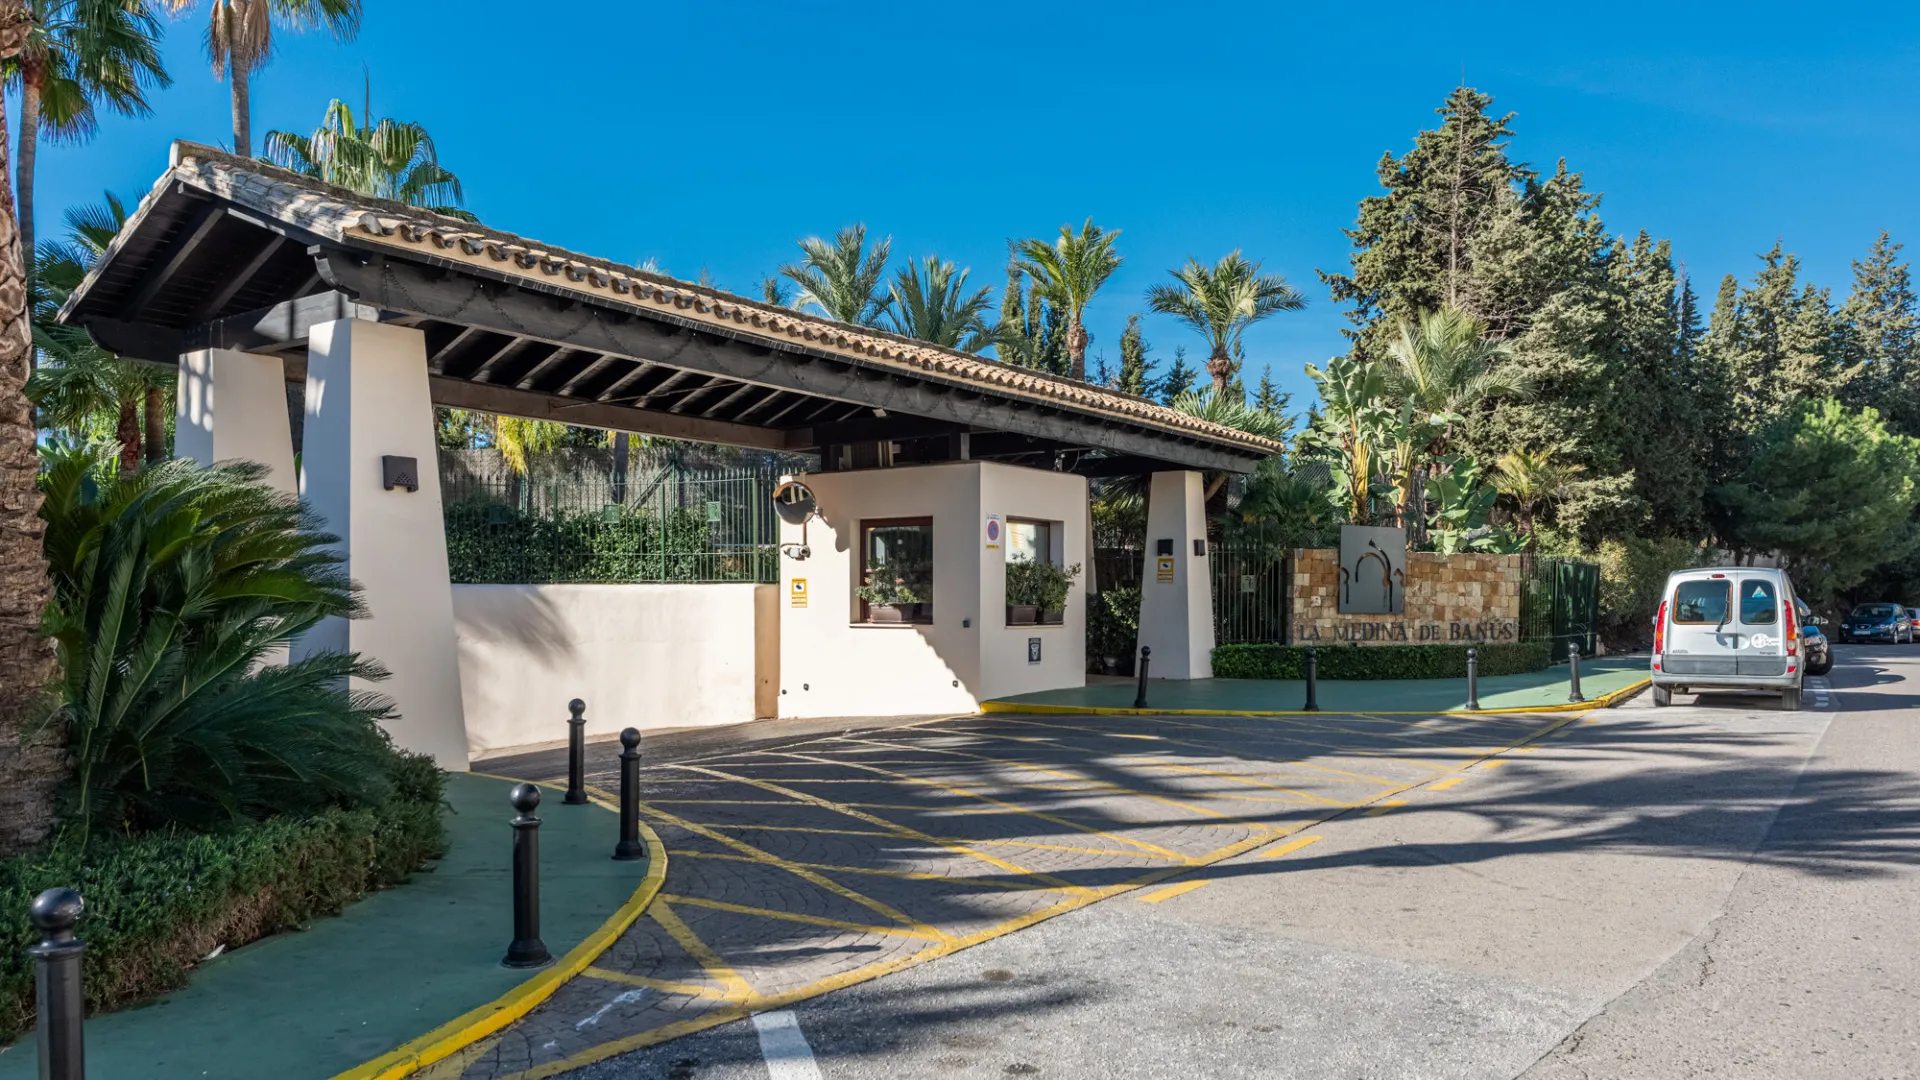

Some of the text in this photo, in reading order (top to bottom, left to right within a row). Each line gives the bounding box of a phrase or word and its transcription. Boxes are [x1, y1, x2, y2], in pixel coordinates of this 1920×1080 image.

[1300, 624, 1321, 641] LA
[1333, 622, 1408, 641] MEDINA
[1420, 625, 1440, 641] DE
